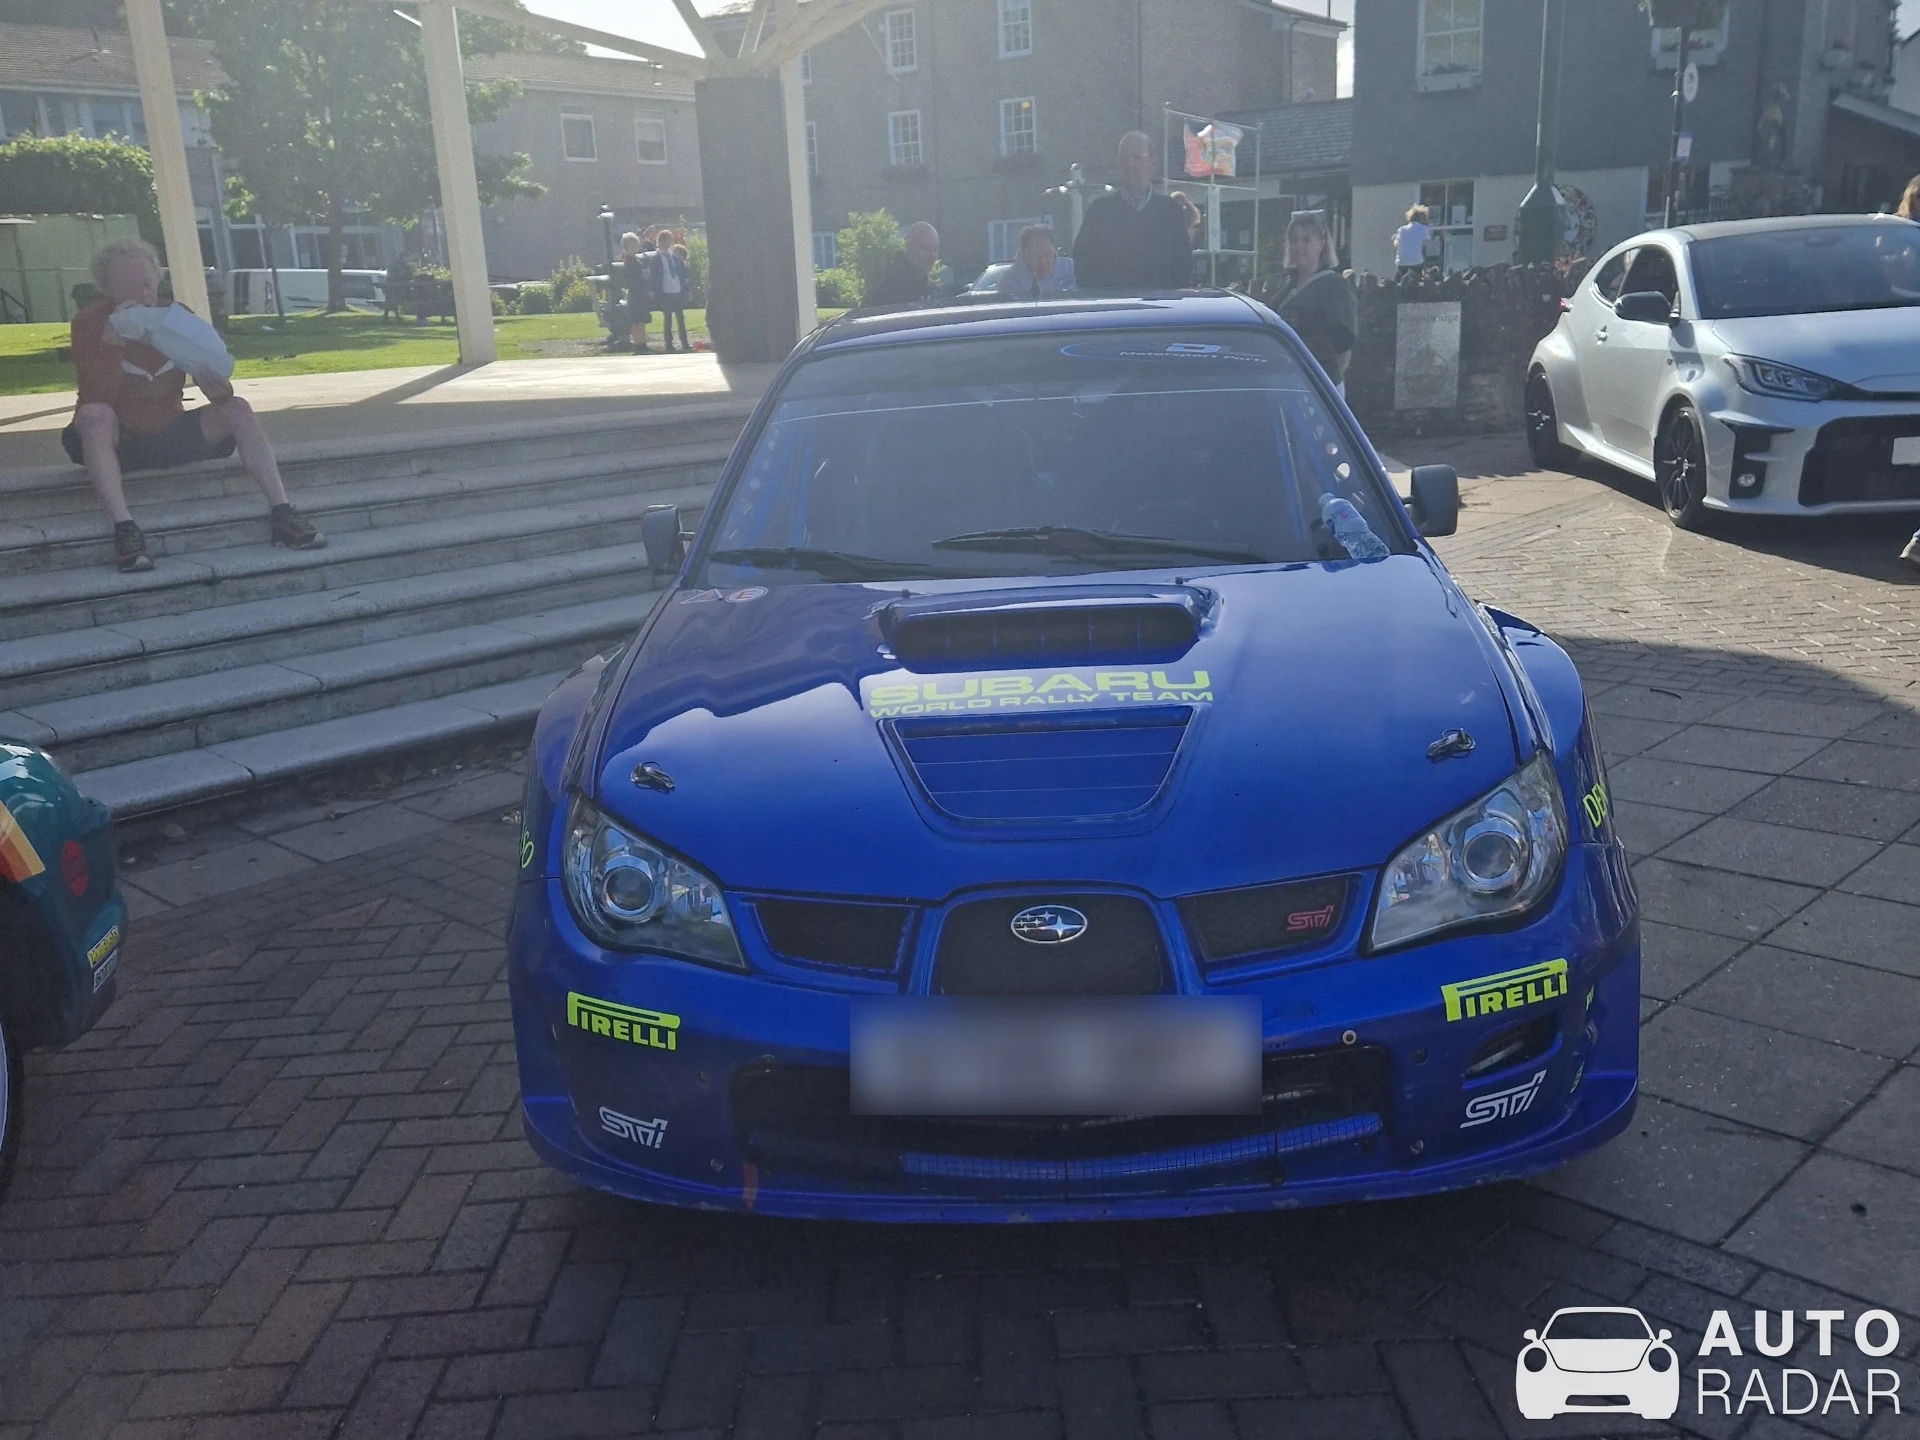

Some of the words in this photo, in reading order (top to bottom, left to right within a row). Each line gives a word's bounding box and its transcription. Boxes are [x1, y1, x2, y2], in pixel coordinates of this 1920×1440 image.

[869, 670, 1211, 706] SUBARU
[869, 698, 991, 719] WORLD
[1000, 693, 1100, 706] RALLY
[1110, 690, 1214, 702] TEAM
[1440, 957, 1569, 1022] PIRELLI
[567, 990, 681, 1051] PIRELLI
